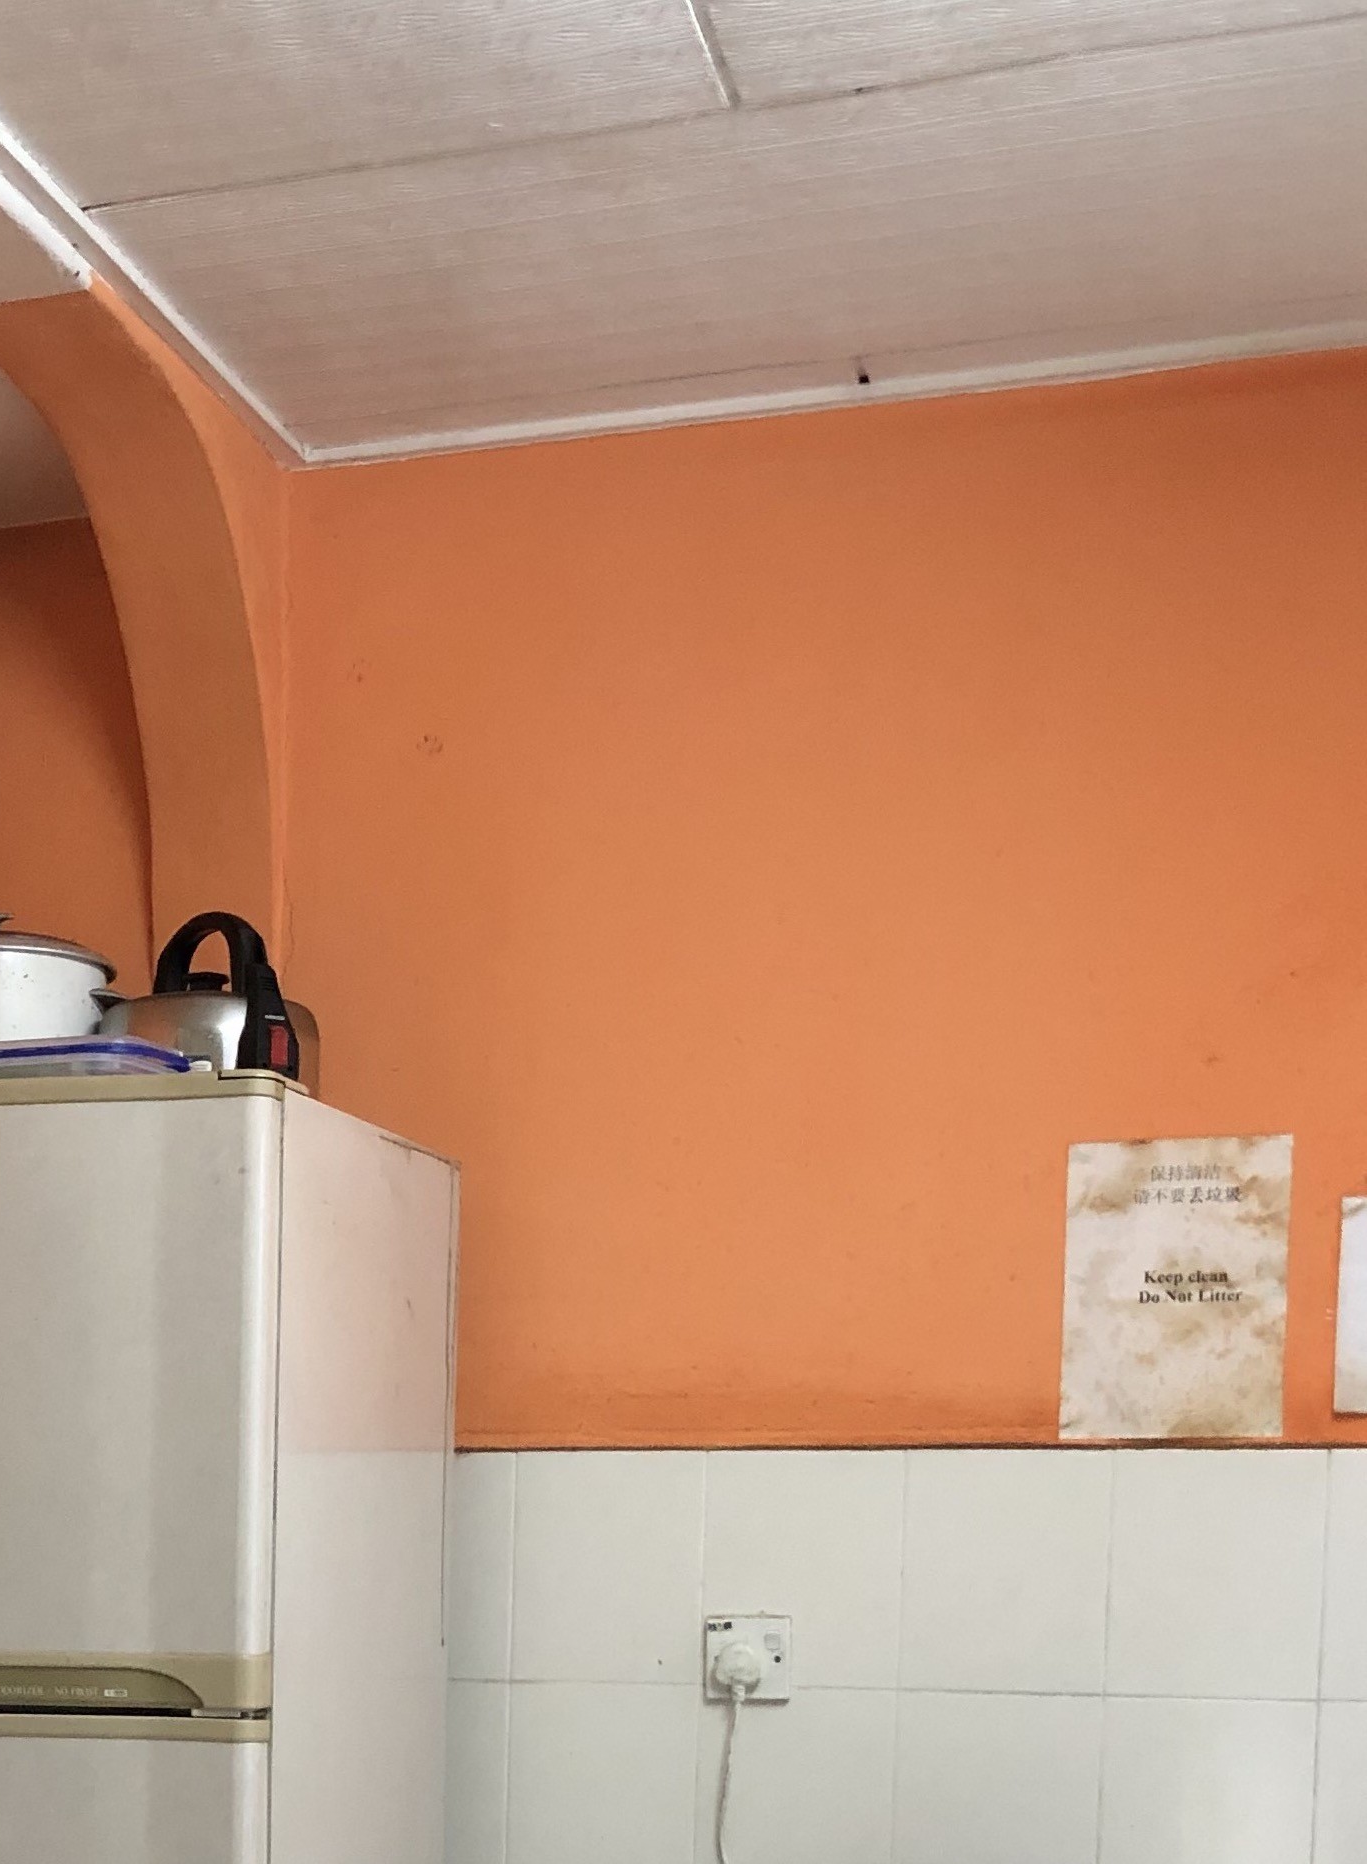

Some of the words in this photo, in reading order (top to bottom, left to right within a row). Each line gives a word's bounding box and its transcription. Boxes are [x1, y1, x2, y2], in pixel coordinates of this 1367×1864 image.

[1144, 1270, 1183, 1286] Keep
[1188, 1270, 1228, 1284] clean
[1139, 1290, 1160, 1303] Do
[1165, 1289, 1193, 1303] Not
[1199, 1289, 1242, 1303] Litter
